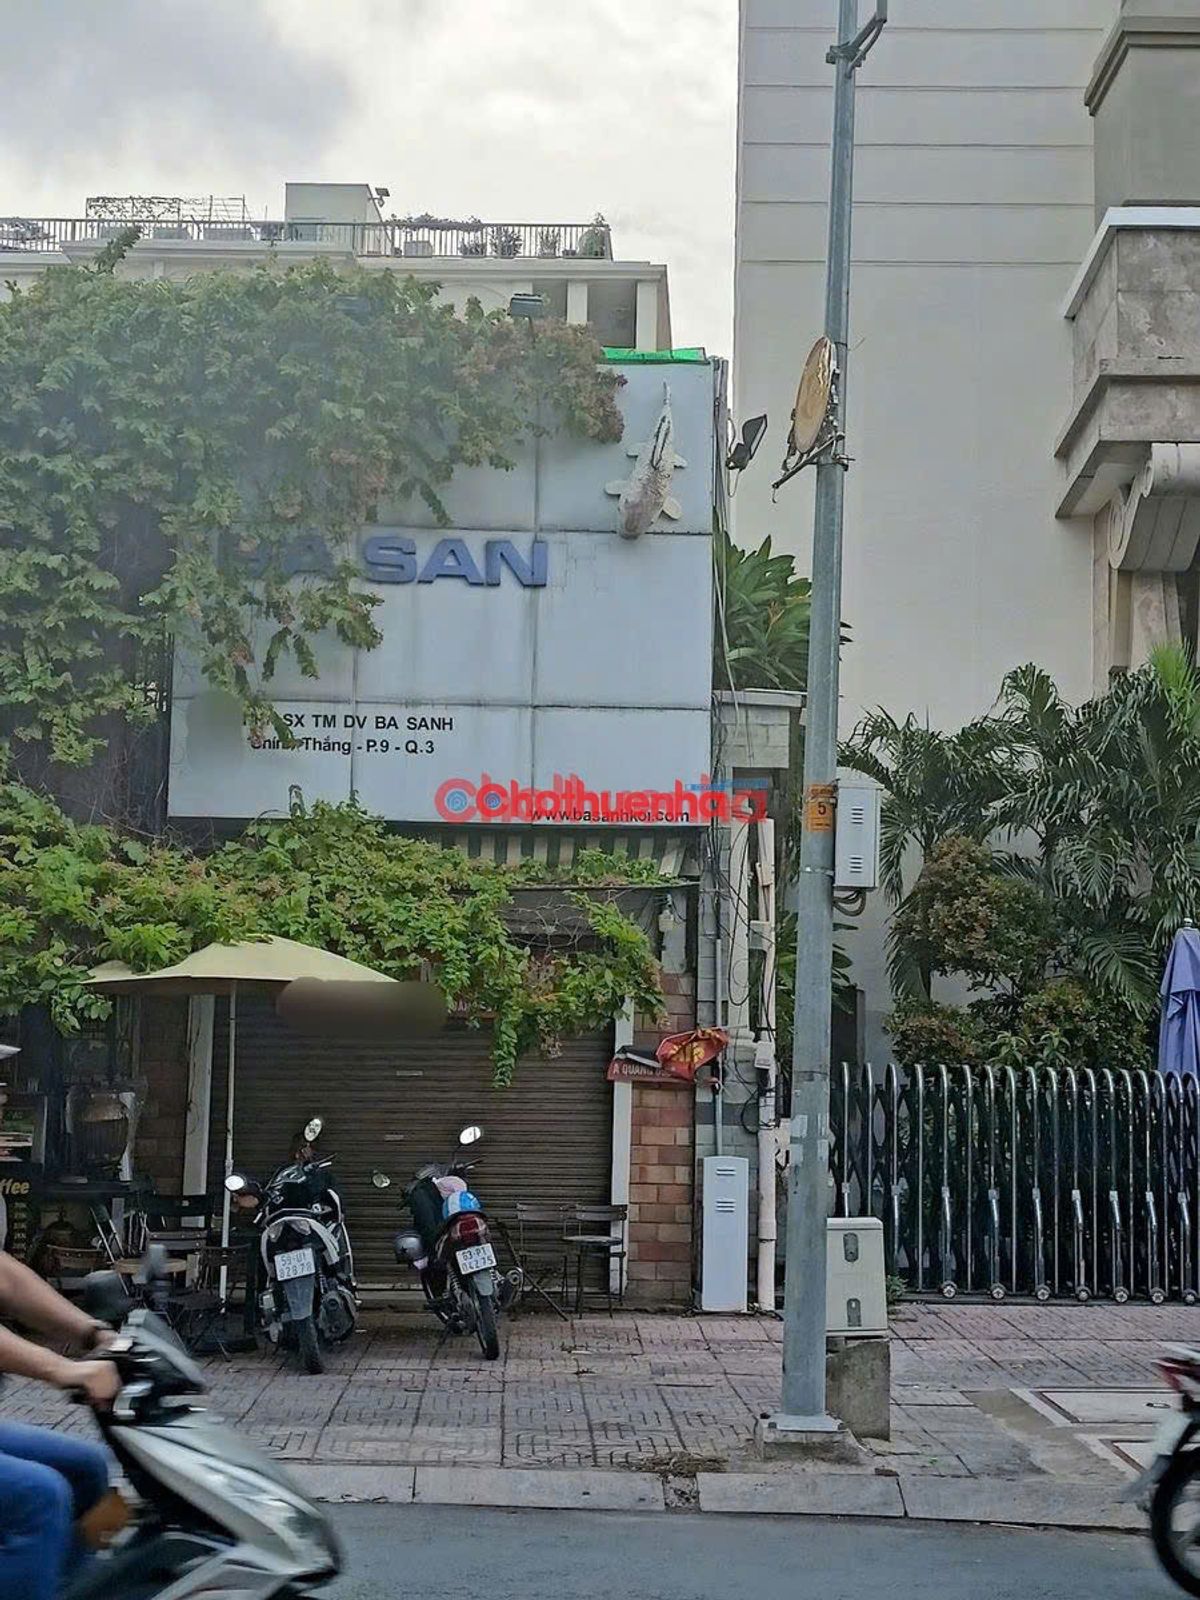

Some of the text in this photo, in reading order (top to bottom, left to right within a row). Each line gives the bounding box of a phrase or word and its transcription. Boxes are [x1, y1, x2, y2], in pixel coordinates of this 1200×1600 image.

[364, 536, 548, 587] SAN
[283, 713, 305, 728] SX
[312, 714, 337, 728] TM
[344, 715, 367, 729] DV
[375, 716, 398, 730] BA
[407, 717, 453, 731] SANH
[302, 736, 351, 755] Thắng
[366, 739, 389, 753] P.9
[405, 740, 434, 754] Q.3
[817, 801, 827, 815] 5
